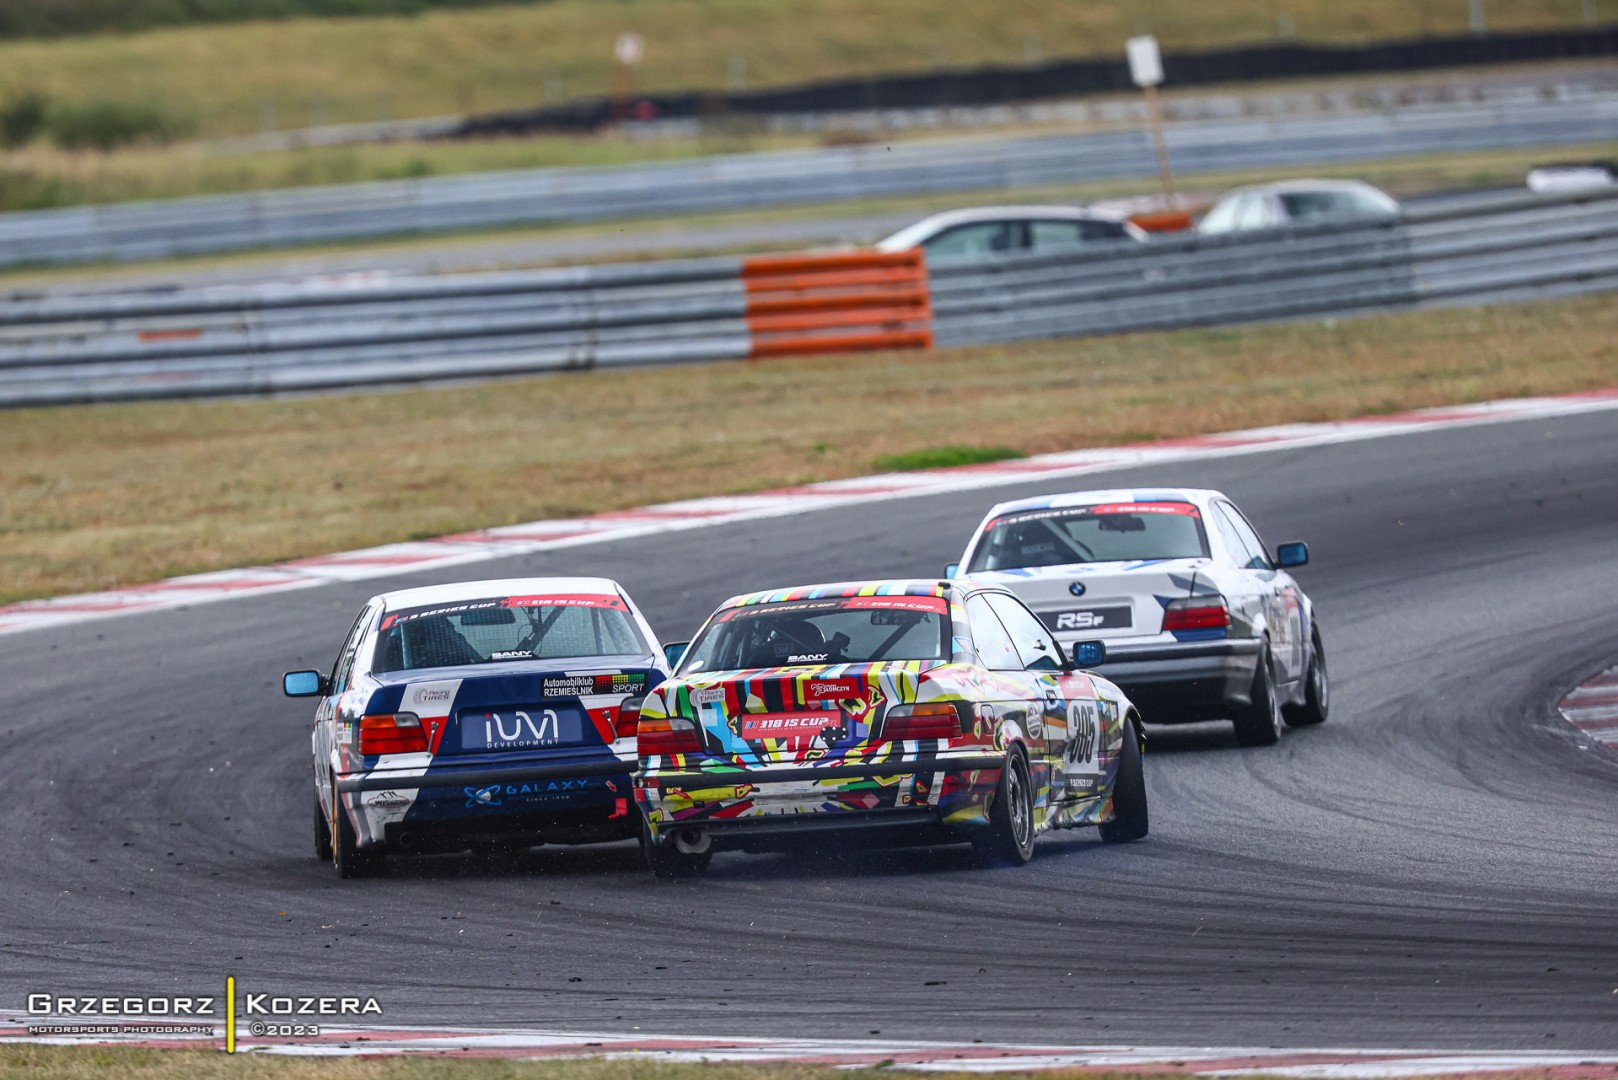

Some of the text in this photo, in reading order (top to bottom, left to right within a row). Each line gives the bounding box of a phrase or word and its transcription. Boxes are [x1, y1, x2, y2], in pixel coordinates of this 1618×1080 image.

[491, 650, 533, 658] BANY
[787, 653, 829, 661] BANY
[543, 676, 594, 687] Automobilklub
[612, 683, 645, 693] SPORT
[759, 718, 784, 729] 318
[783, 718, 800, 728] IS
[799, 717, 829, 728] CUP
[486, 738, 559, 749] DEVELOPMENT
[506, 779, 588, 795] GALAXY
